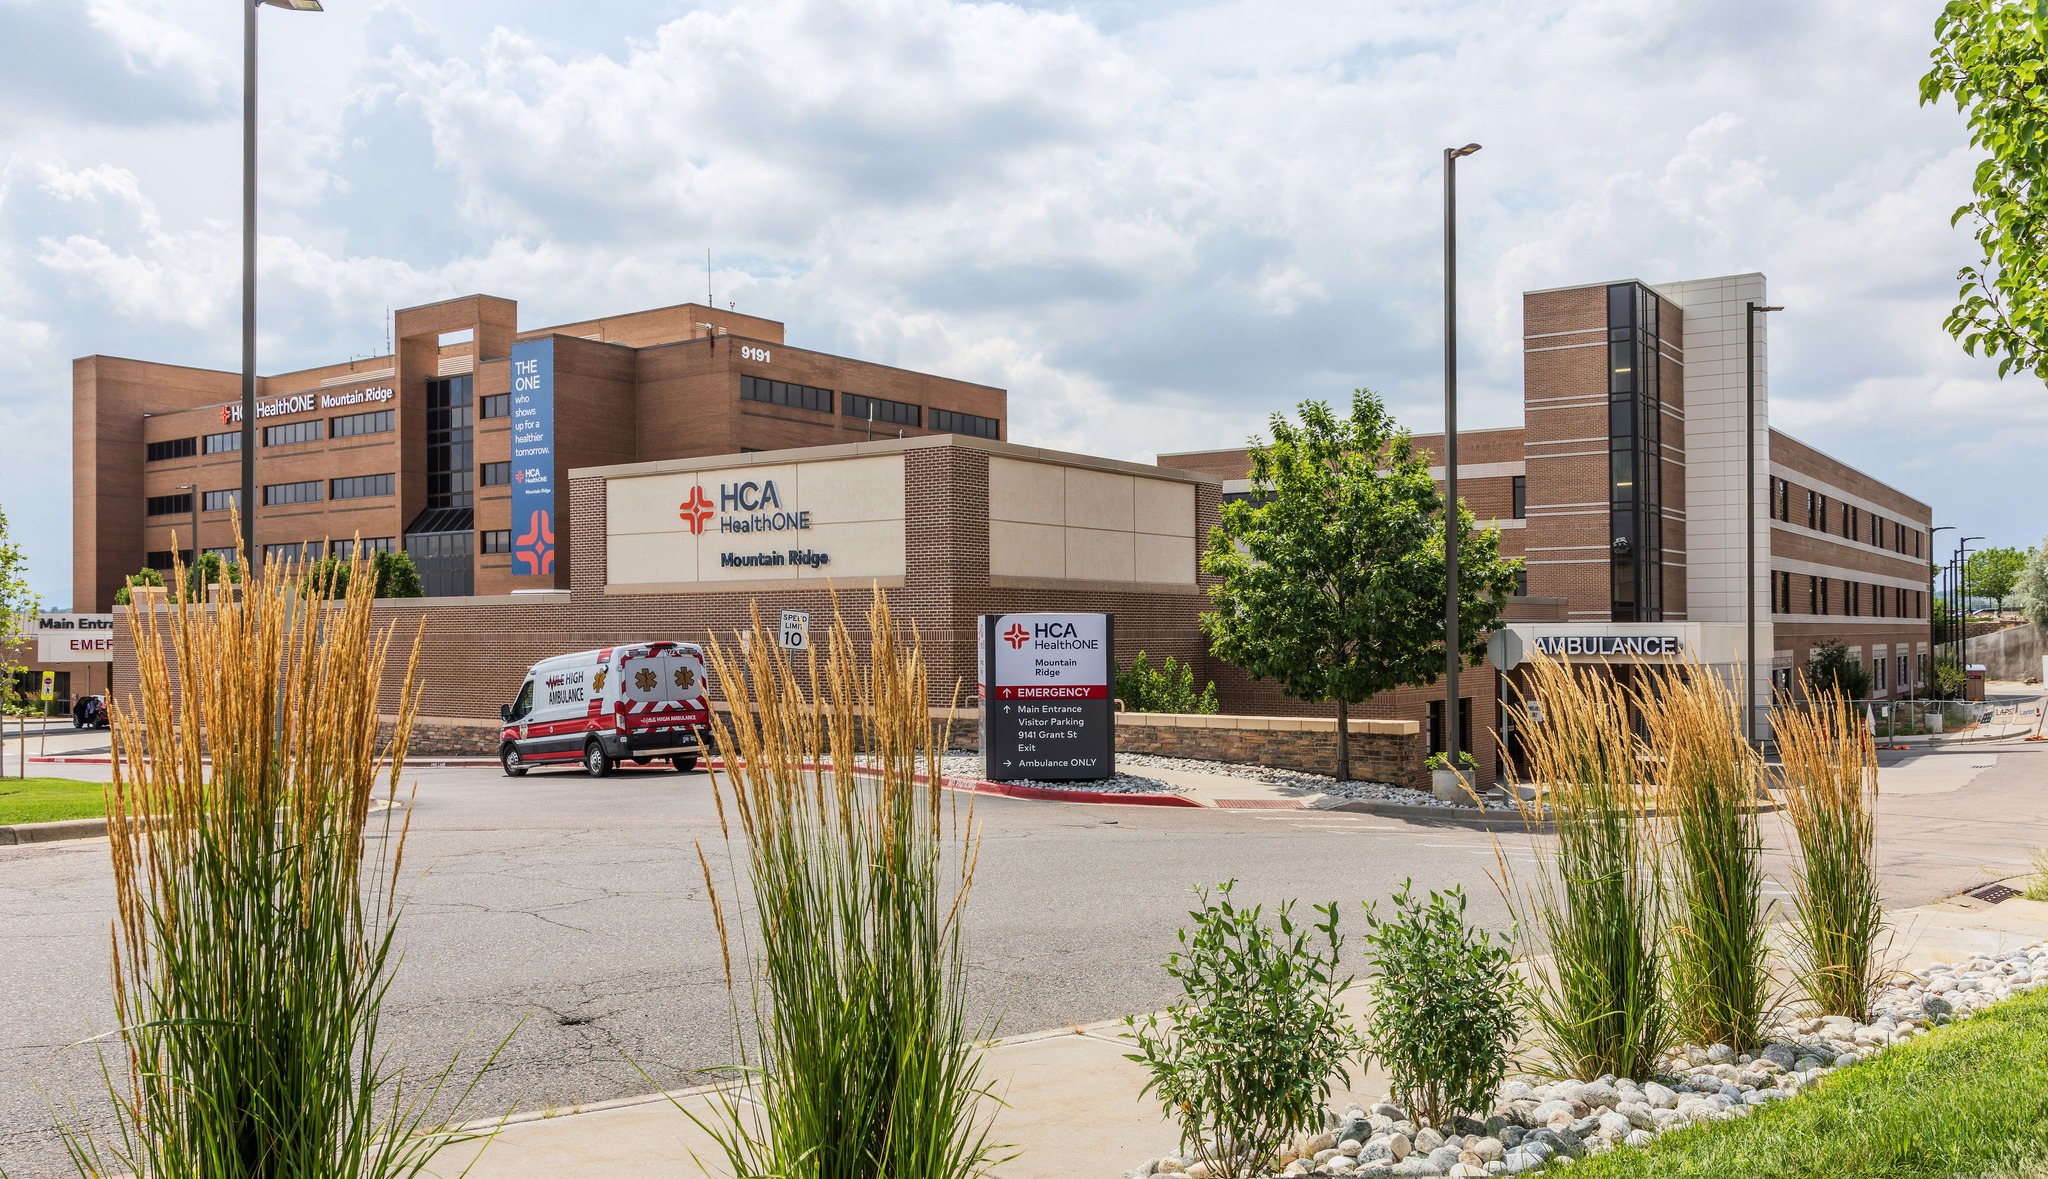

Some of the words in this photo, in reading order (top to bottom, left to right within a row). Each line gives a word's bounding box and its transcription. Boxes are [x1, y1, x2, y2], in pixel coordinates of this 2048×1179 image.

[741, 345, 770, 363] 9191
[515, 359, 538, 375] THE
[515, 375, 540, 391] ONE
[256, 394, 315, 418] HealthONE
[321, 389, 364, 408] Mountain
[365, 386, 393, 402] Ridge
[515, 394, 530, 403] who
[515, 408, 536, 417] shows
[515, 423, 524, 432] up
[524, 420, 534, 429] for
[515, 433, 544, 443] healthier
[525, 468, 541, 478] HCA
[720, 480, 781, 512] HCA
[720, 511, 811, 533] HealthONE
[720, 551, 785, 567] Mountain
[788, 550, 830, 568] Ridge
[39, 618, 75, 629] Main
[1035, 623, 1077, 638] HCA
[785, 631, 802, 646] 10
[1035, 640, 1099, 650] HealthONE
[1536, 637, 1676, 655] AMBULANCE
[565, 671, 584, 685] HIGH
[1035, 669, 1060, 677] Ridge
[549, 687, 584, 705] AMBULANCE
[1018, 688, 1090, 697] EMERGENCY
[1042, 705, 1082, 713] Entrance
[1018, 718, 1048, 726] Visitor
[1051, 718, 1084, 727] Parking
[1018, 731, 1036, 739] 9141
[1039, 730, 1065, 739] Grant
[1067, 730, 1078, 739] St
[1018, 744, 1036, 752] Exit
[1019, 759, 1068, 767] Ambulance
[1070, 758, 1097, 767] ONLY
